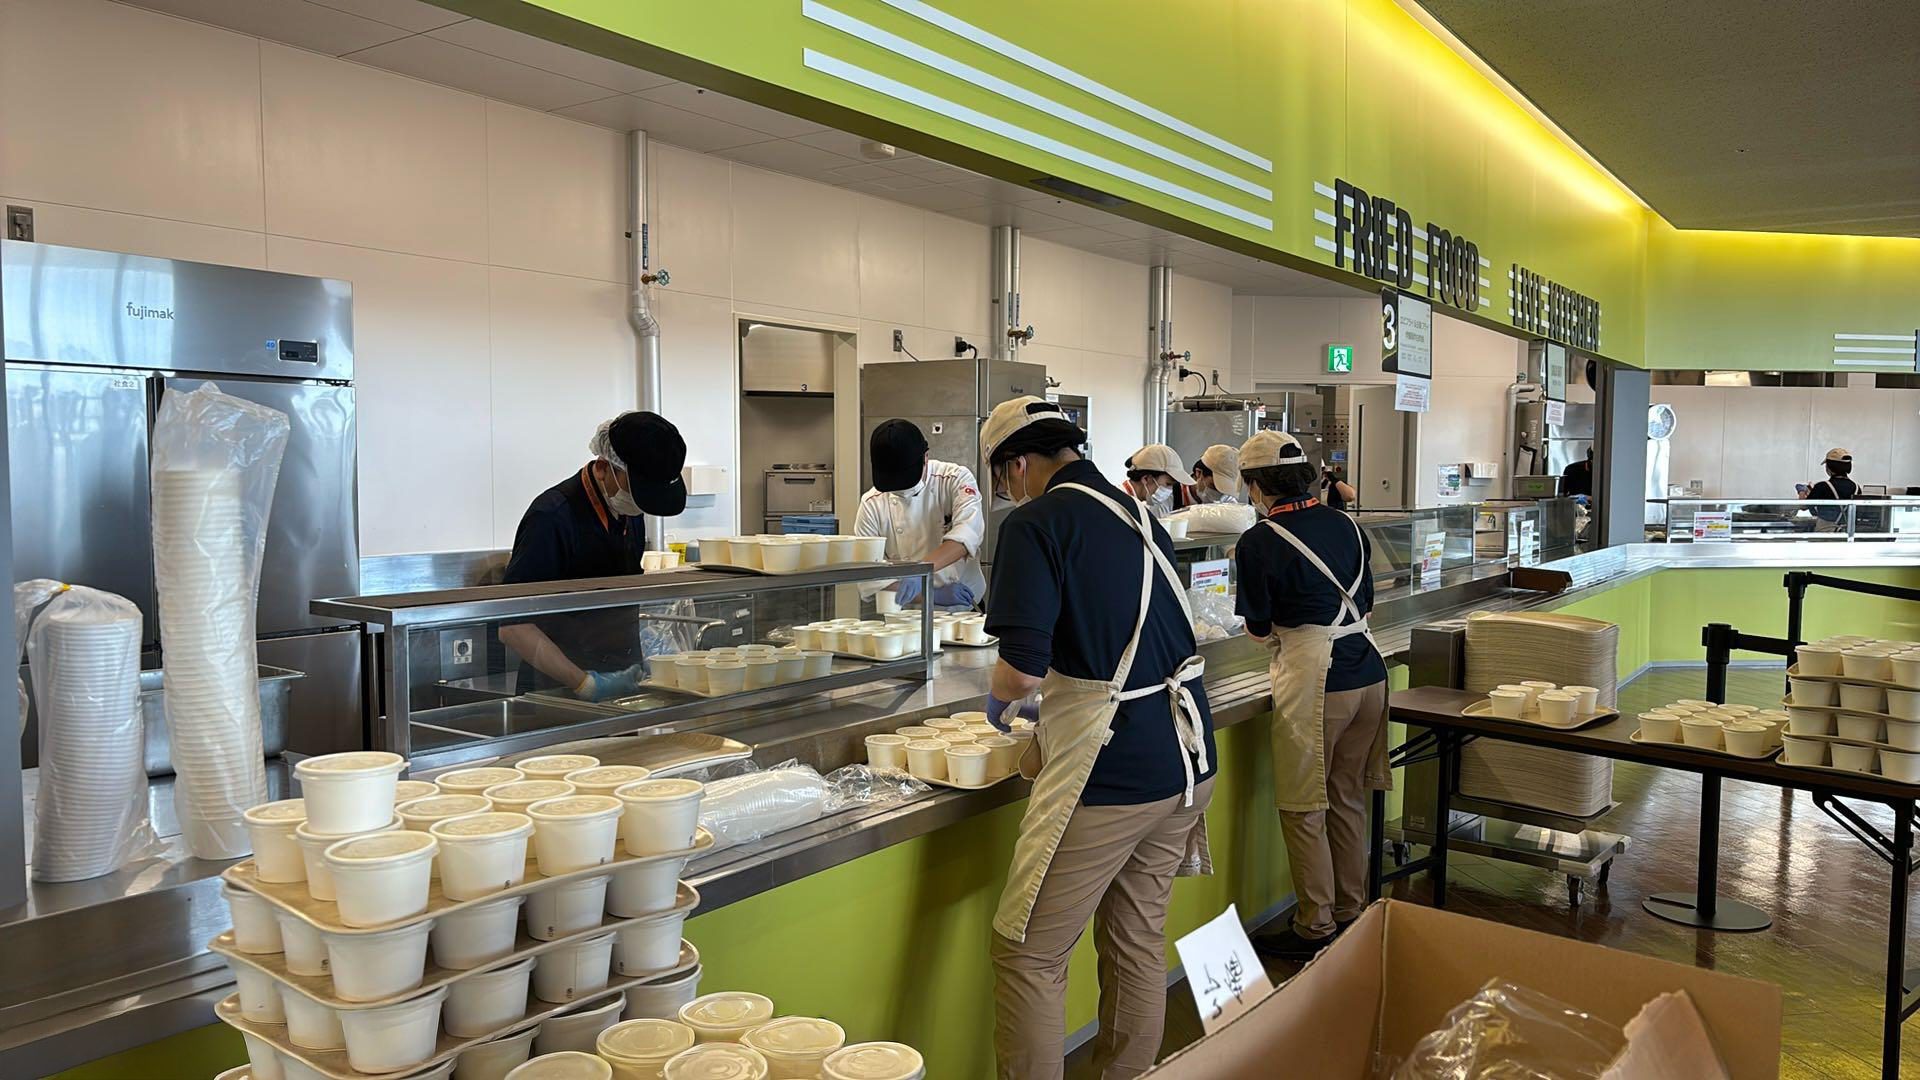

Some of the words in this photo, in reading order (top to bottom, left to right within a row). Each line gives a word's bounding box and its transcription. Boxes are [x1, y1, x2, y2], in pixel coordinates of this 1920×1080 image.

[1334, 178, 1414, 289] FRIED
[1426, 222, 1480, 312] FOOD
[126, 302, 174, 320] fujimak
[1383, 304, 1396, 350] 3
[1512, 263, 1546, 335] LIVE
[1548, 280, 1600, 352] KITCHEN
[800, 383, 808, 391] 3
